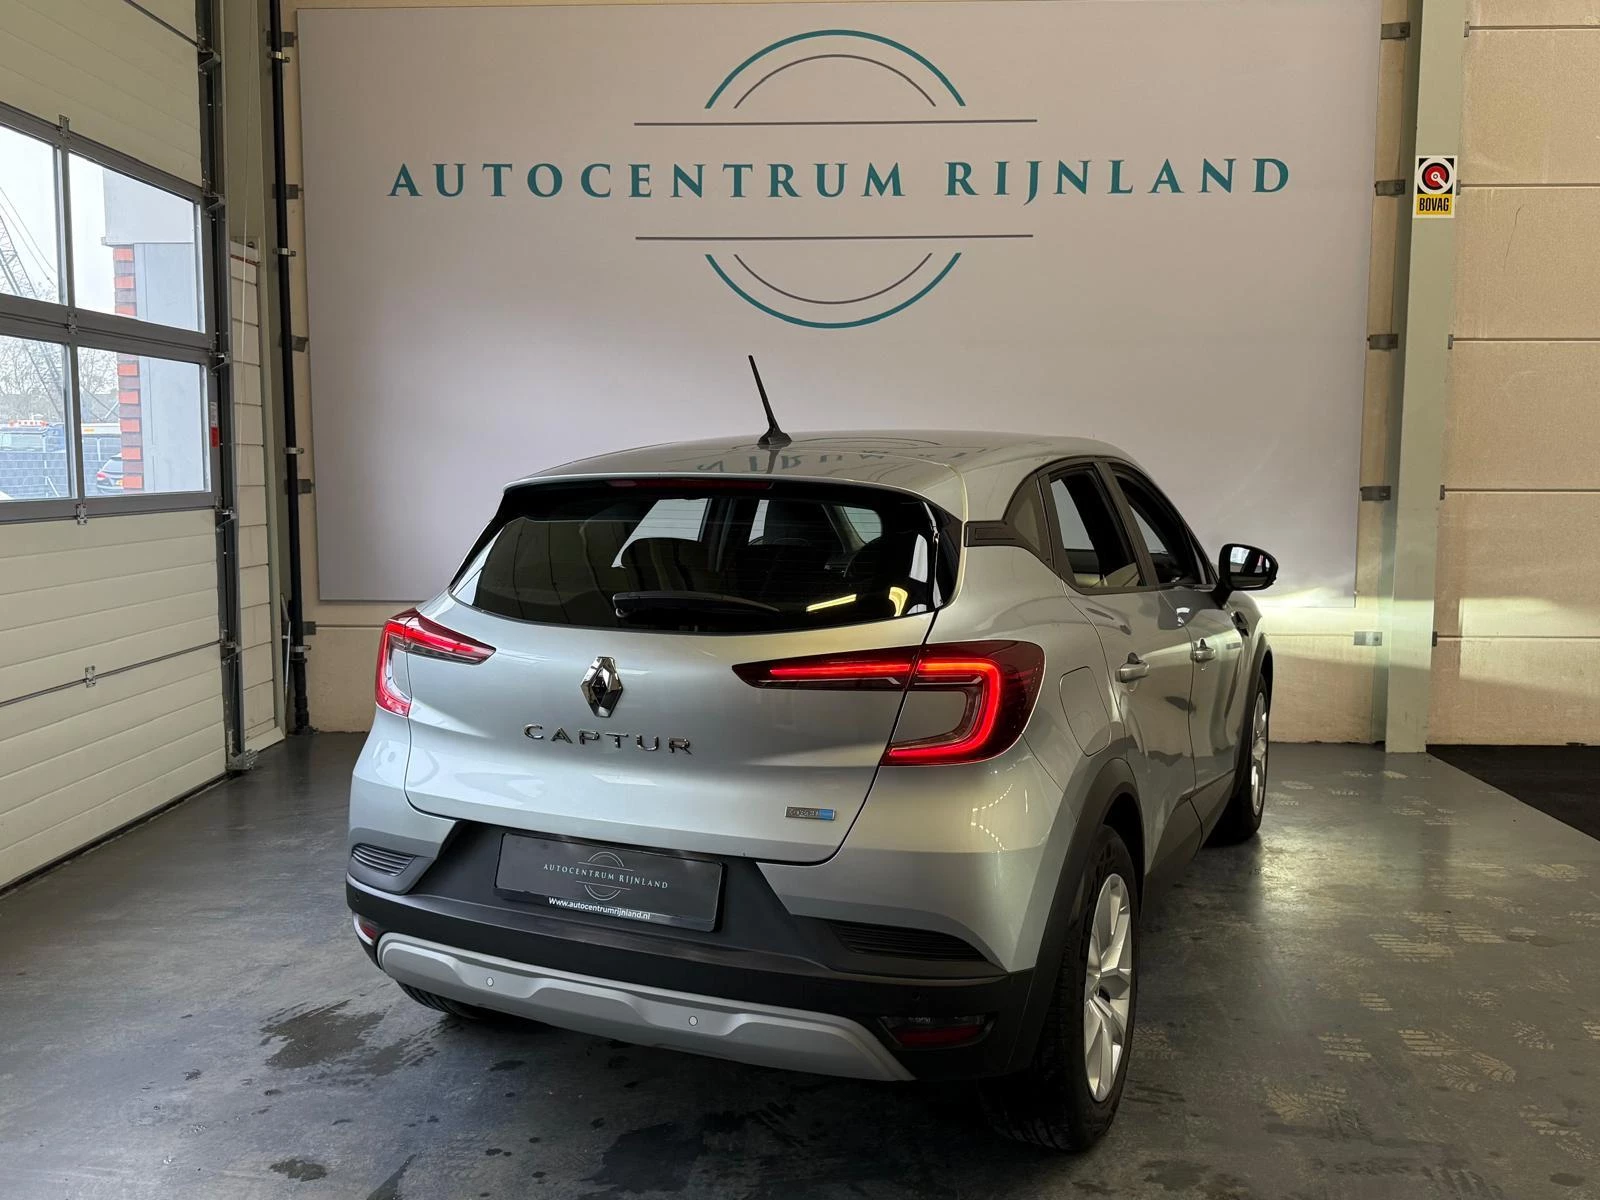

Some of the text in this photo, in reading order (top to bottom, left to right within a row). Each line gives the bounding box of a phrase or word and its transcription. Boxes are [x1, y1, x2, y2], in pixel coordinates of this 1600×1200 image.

[387, 157, 1290, 206] AUTOCENTRUM RIJNLAND
[1419, 197, 1449, 212] BOVAG
[523, 723, 693, 755] CAPTUR
[543, 863, 668, 889] AUTOCENTRUM RIJNLAND
